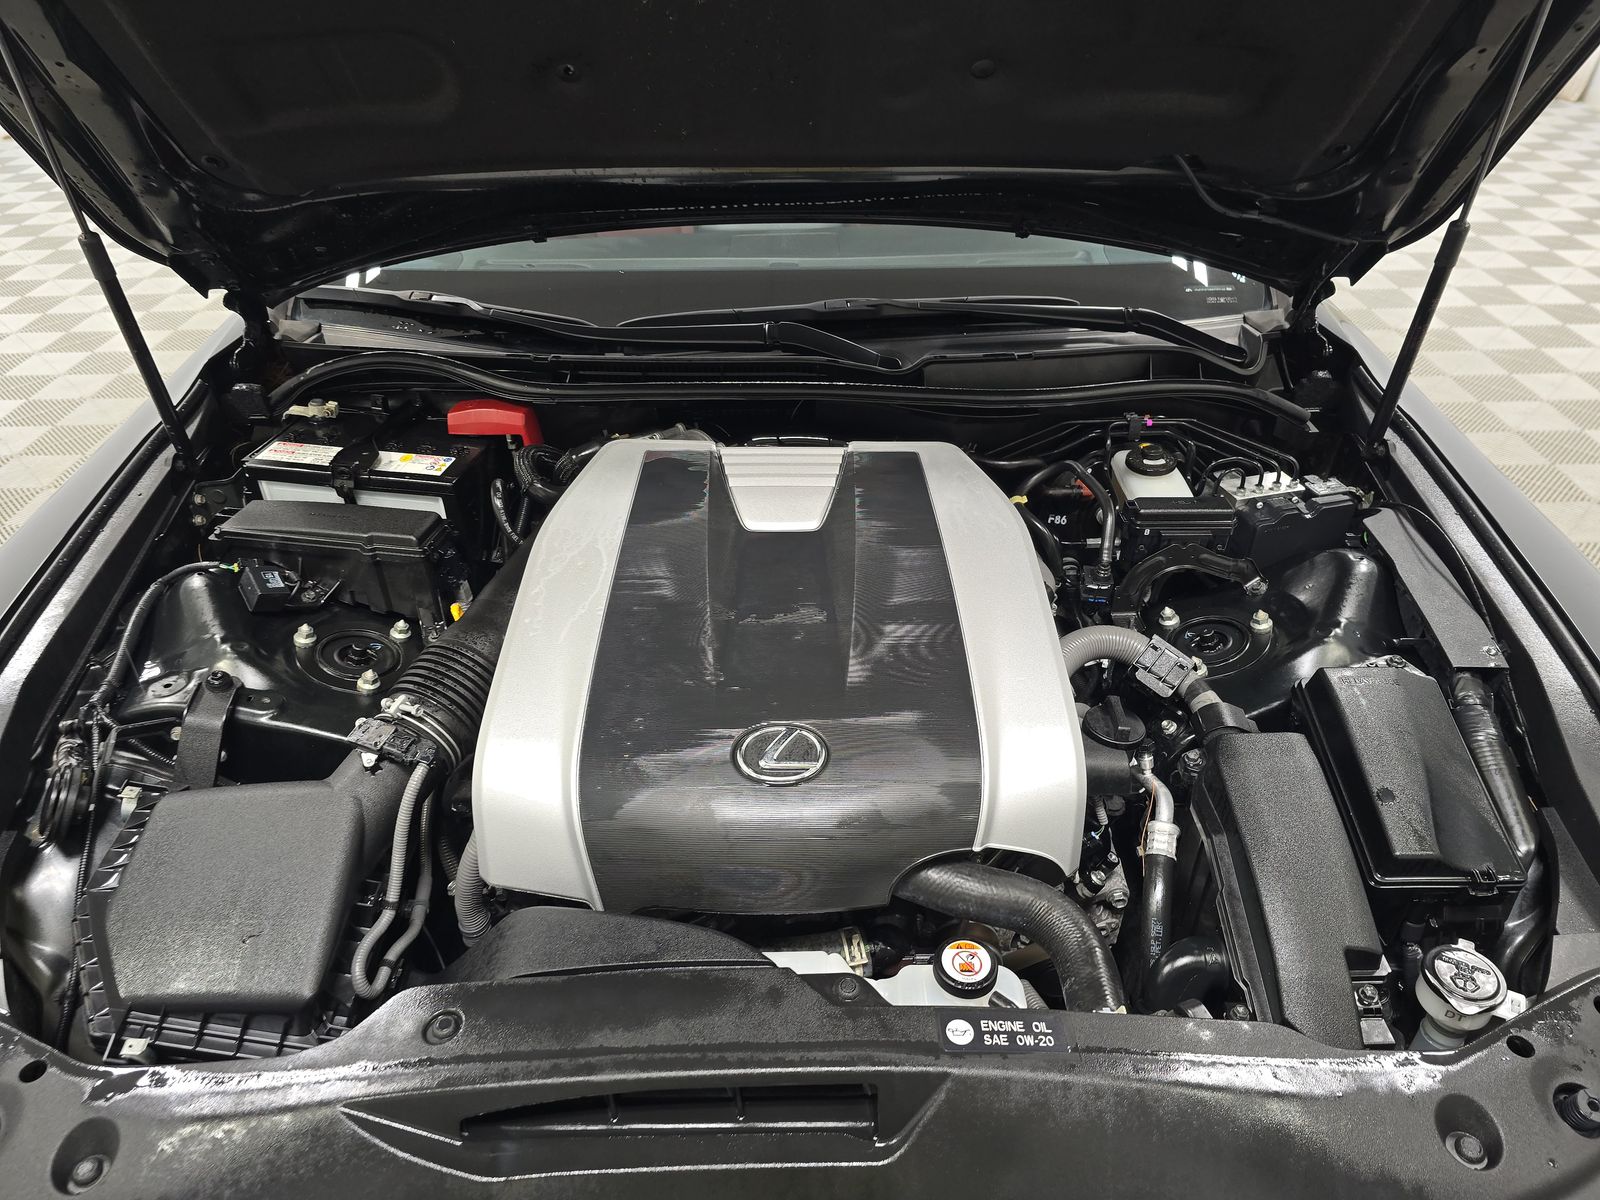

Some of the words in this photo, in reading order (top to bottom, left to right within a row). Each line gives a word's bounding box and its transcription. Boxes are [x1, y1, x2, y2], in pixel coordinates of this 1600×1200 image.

[1048, 514, 1068, 525] F86
[1444, 1009, 1467, 1022] DT
[980, 1020, 1026, 1032] ENGINE
[1032, 1021, 1053, 1033] OIL
[983, 1034, 1009, 1046] SAE
[1016, 1035, 1055, 1047] 0W-20
